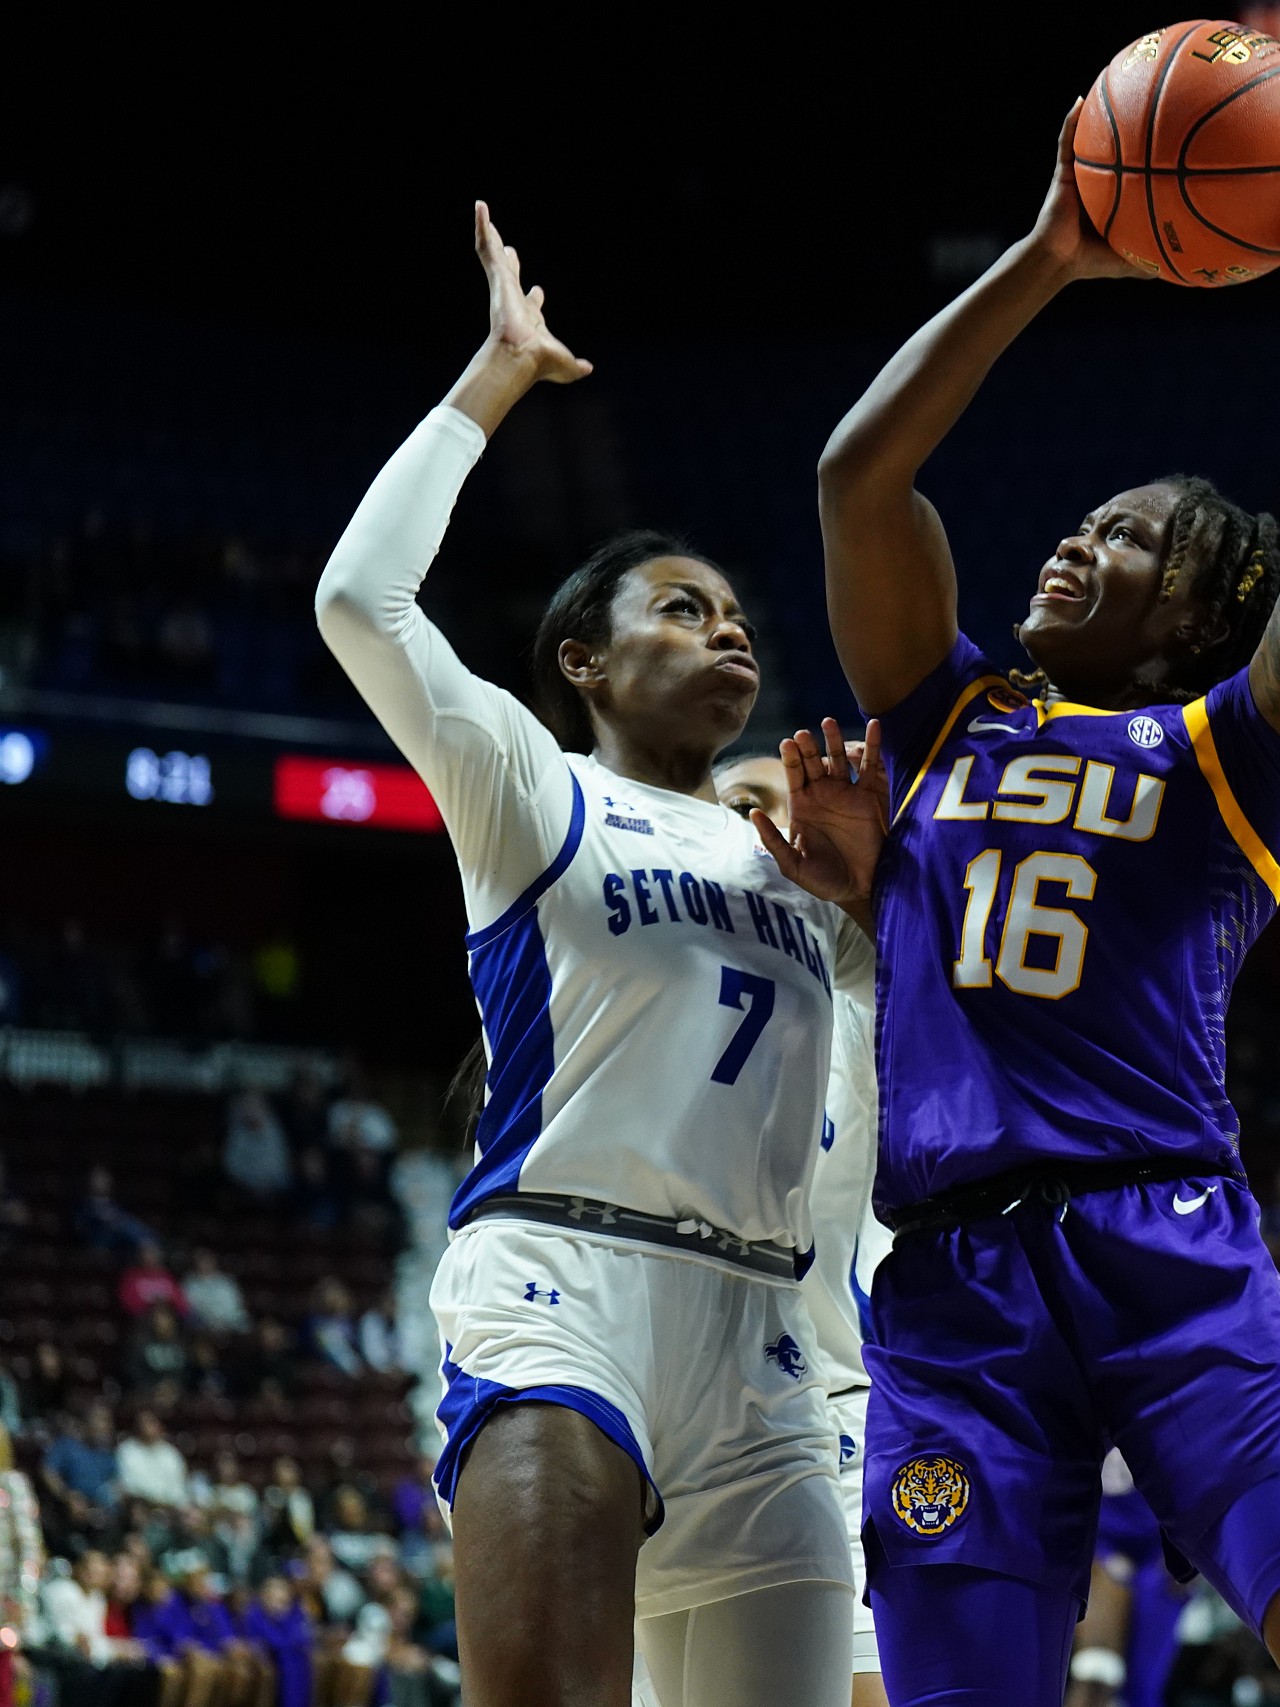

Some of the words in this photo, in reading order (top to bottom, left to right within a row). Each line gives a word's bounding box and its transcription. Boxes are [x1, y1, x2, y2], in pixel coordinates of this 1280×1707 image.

[1130, 716, 1163, 747] SEC
[933, 753, 1167, 842] LSU
[603, 868, 735, 937] SETON
[953, 848, 1098, 1000] 16
[710, 965, 776, 1086] 7
